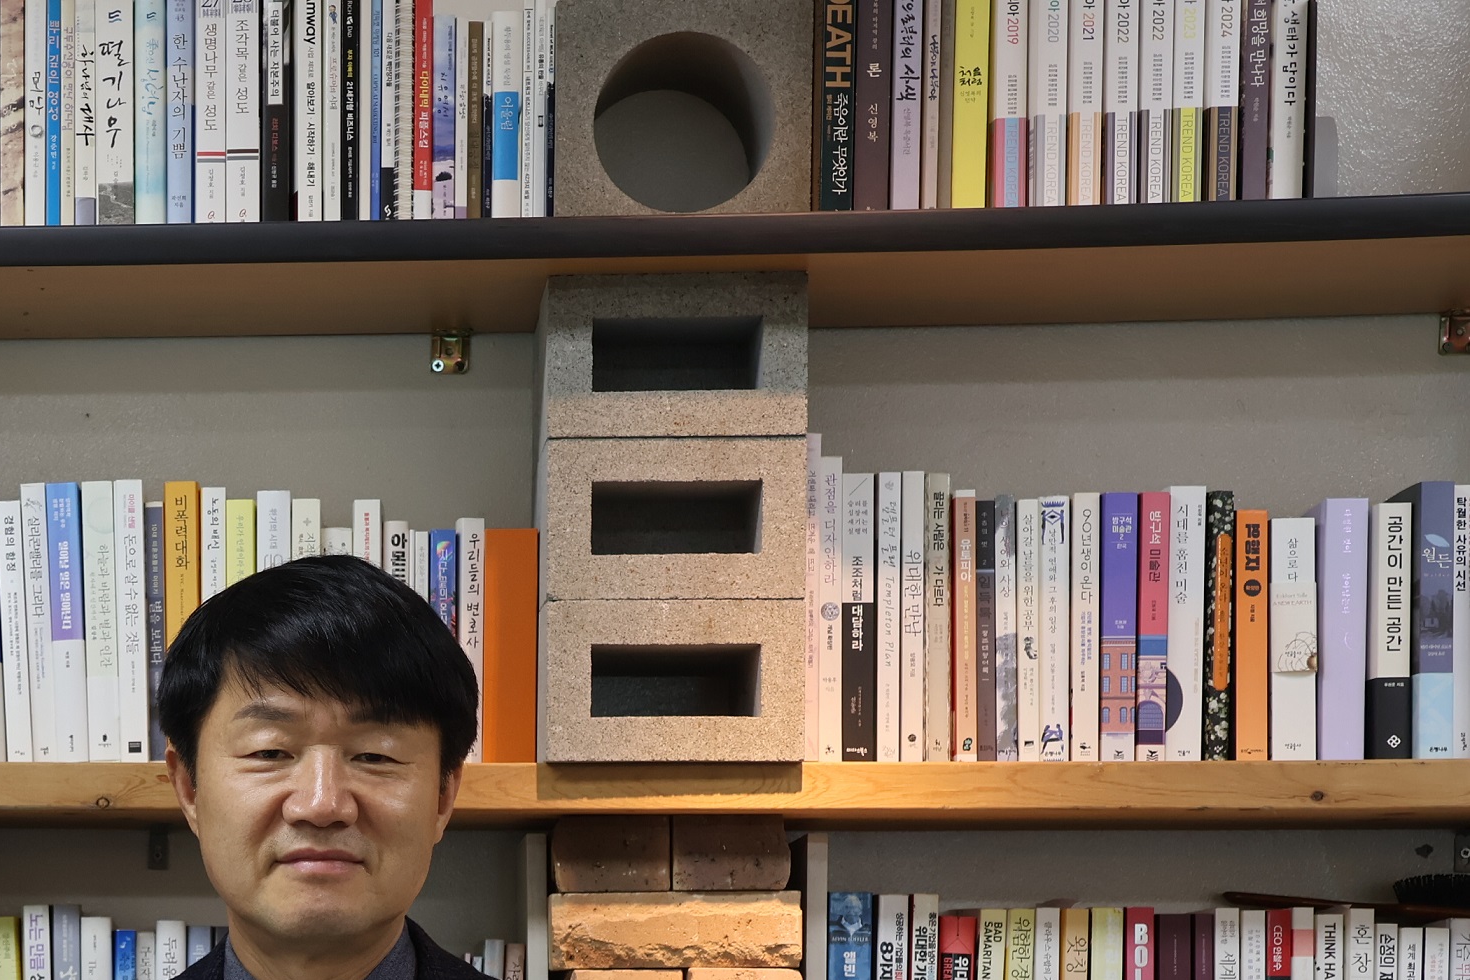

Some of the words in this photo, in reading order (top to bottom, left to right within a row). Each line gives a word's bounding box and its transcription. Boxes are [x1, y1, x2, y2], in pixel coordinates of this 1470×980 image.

[303, 0, 316, 44] mway
[1006, 17, 1019, 45] 2019
[1082, 10, 1095, 42] 2021
[1117, 12, 1130, 43] 2022
[1220, 6, 1233, 37] 2024
[867, 104, 879, 142] 신영복
[1116, 117, 1128, 156] TREND
[1116, 161, 1128, 202] KOREA
[173, 494, 190, 570] 비폭력대화
[1149, 511, 1161, 545] 방구석
[1387, 516, 1403, 569] 공간이
[851, 556, 864, 601] 조조처럼
[1148, 549, 1161, 583] 미술관
[1387, 577, 1403, 610] 만든
[851, 605, 864, 651] 대답하라
[1386, 617, 1402, 652] 공간
[914, 926, 927, 964] 위대한
[994, 923, 1002, 942] BAD
[1325, 923, 1337, 959] THINK
